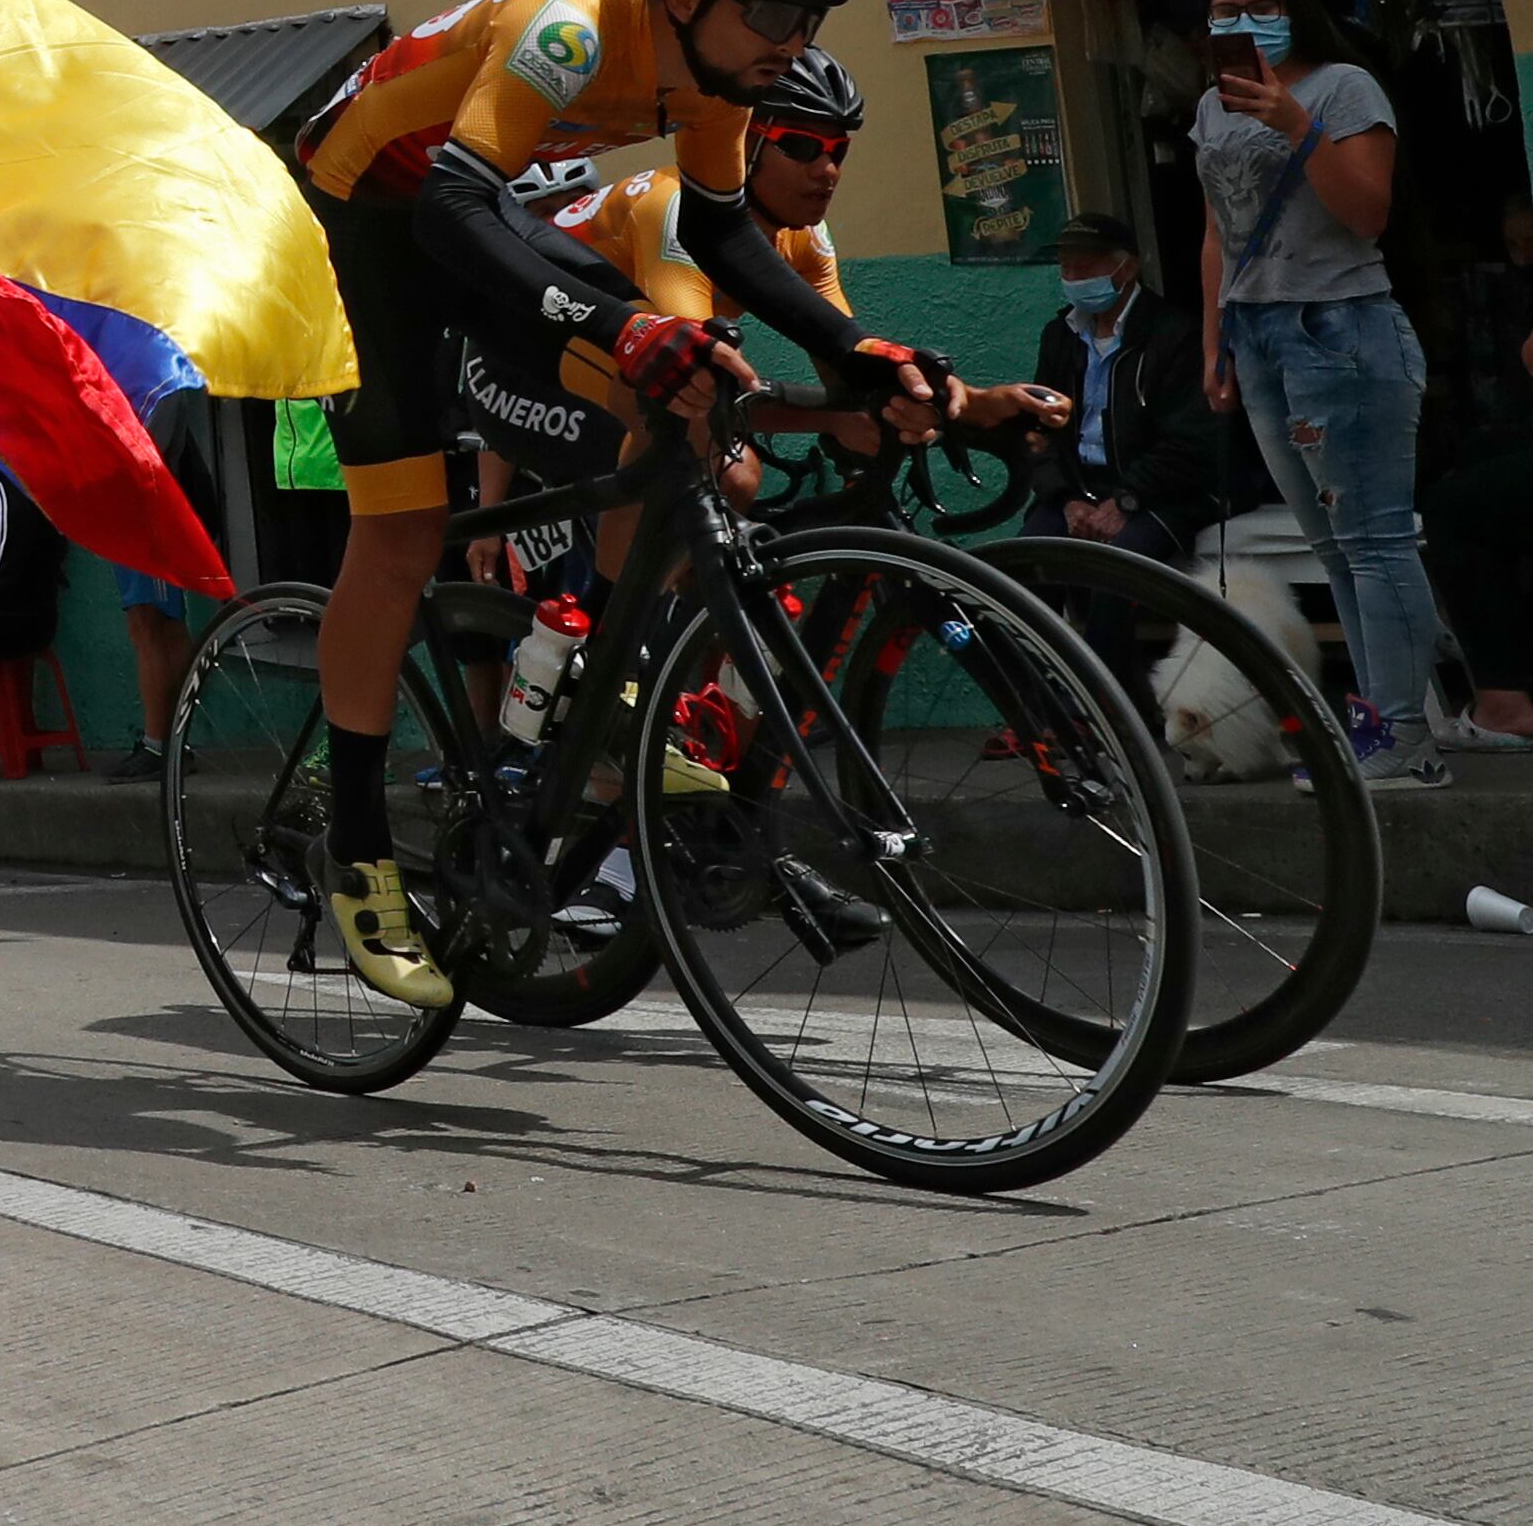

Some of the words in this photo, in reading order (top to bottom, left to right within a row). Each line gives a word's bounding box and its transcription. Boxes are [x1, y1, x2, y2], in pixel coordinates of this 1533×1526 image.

[956, 139, 1011, 163] DISFRUTA
[965, 164, 1022, 190] DEVUELVE
[466, 356, 586, 442] LLANEROS
[514, 519, 571, 569] 184
